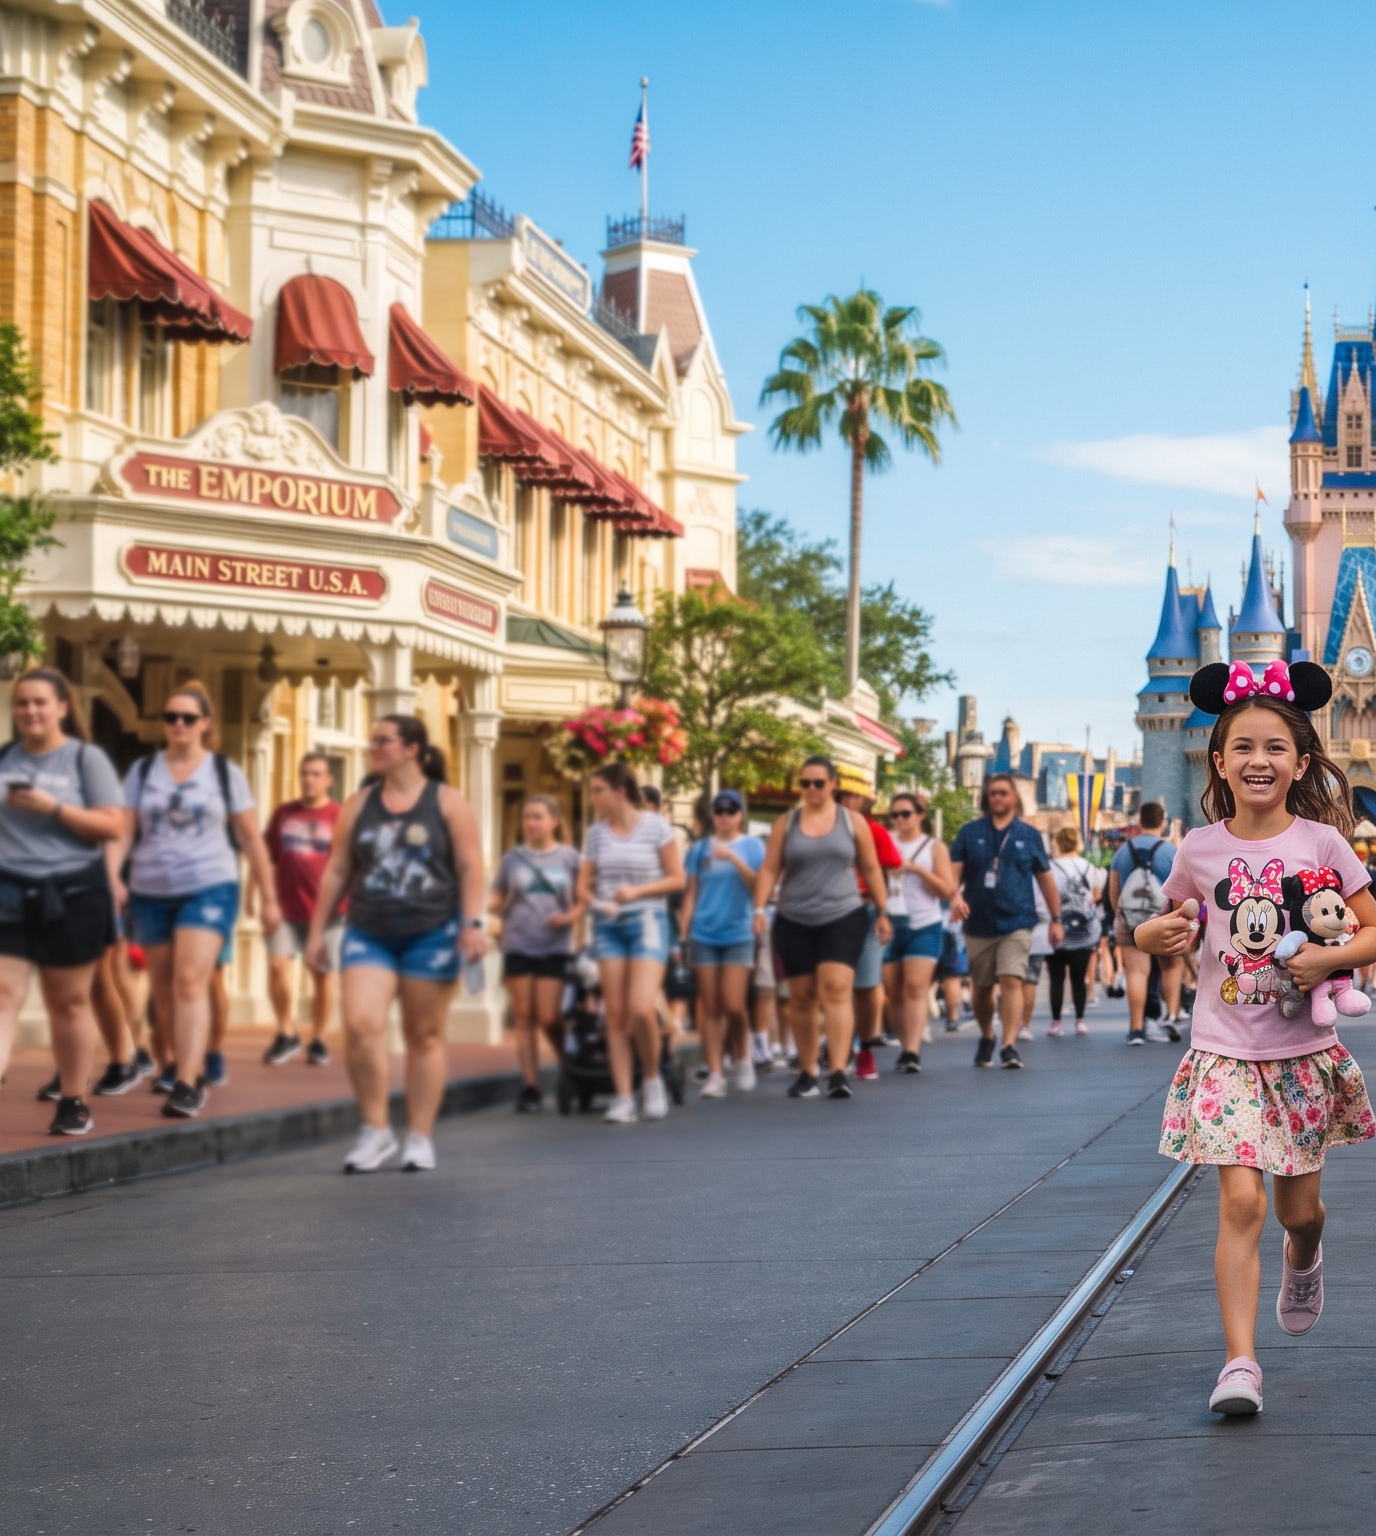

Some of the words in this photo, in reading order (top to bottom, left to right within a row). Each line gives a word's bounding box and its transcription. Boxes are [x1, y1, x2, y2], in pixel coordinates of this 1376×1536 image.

[143, 463, 192, 490] THE
[197, 465, 379, 520] EMPORIUM
[147, 551, 211, 578] MAIN
[217, 560, 303, 588] STREET
[308, 568, 368, 596] U.S.A.
